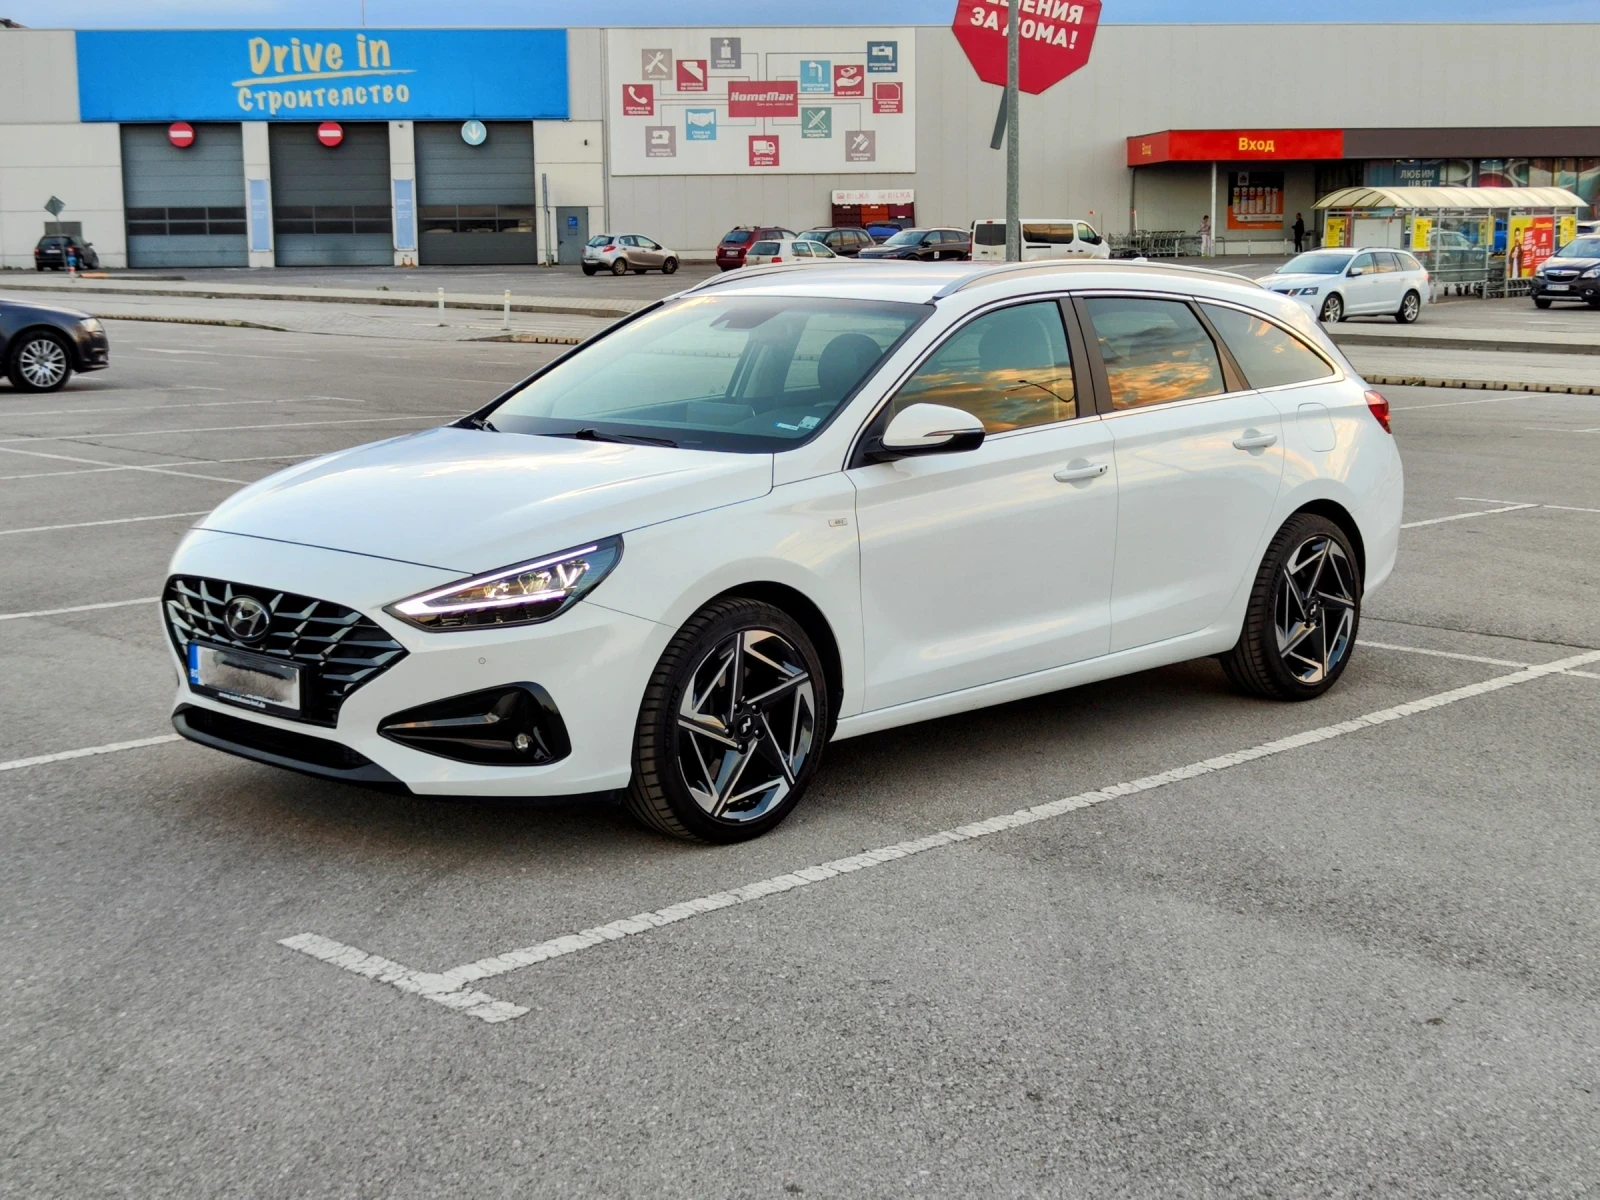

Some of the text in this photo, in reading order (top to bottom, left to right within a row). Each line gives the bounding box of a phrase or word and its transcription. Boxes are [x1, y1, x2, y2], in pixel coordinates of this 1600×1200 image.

[970, 6, 998, 30] ЗА
[985, 0, 1084, 24] ЕНИЯ
[248, 33, 391, 75] Drive in
[238, 84, 410, 115] Строителство
[1238, 138, 1275, 152] Вход
[1400, 170, 1435, 178] ЛЮБИМ
